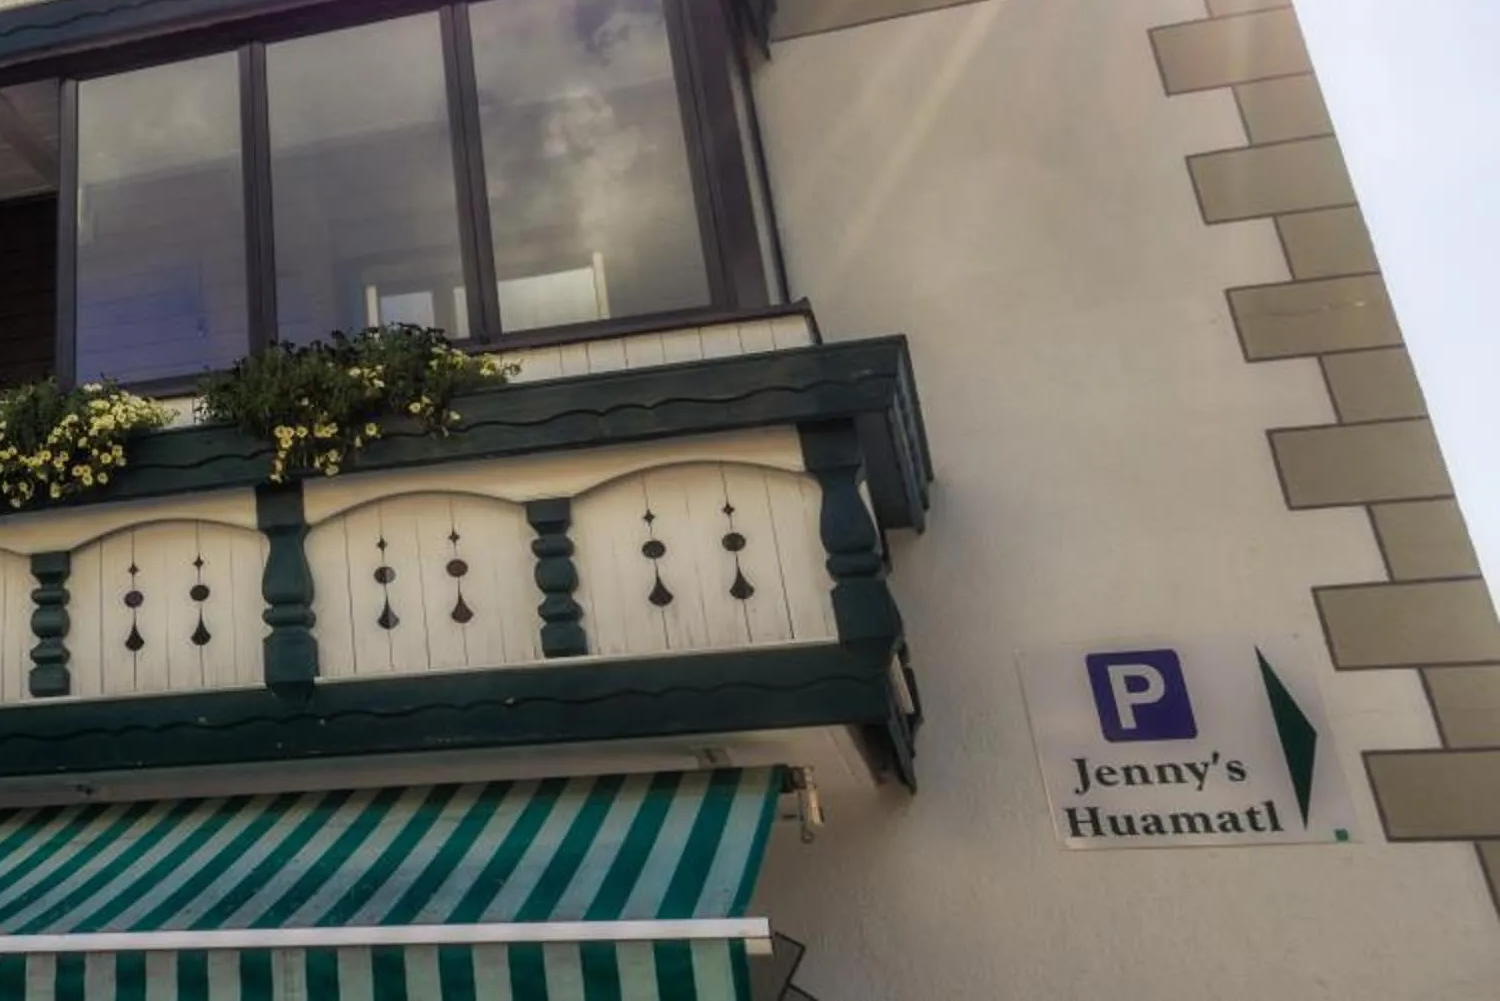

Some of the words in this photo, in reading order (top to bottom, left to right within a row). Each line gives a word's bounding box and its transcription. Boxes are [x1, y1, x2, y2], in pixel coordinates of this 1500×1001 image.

[1107, 664, 1165, 729] P
[1073, 751, 1248, 795] Jenny's
[1064, 800, 1284, 838] Huamatl
